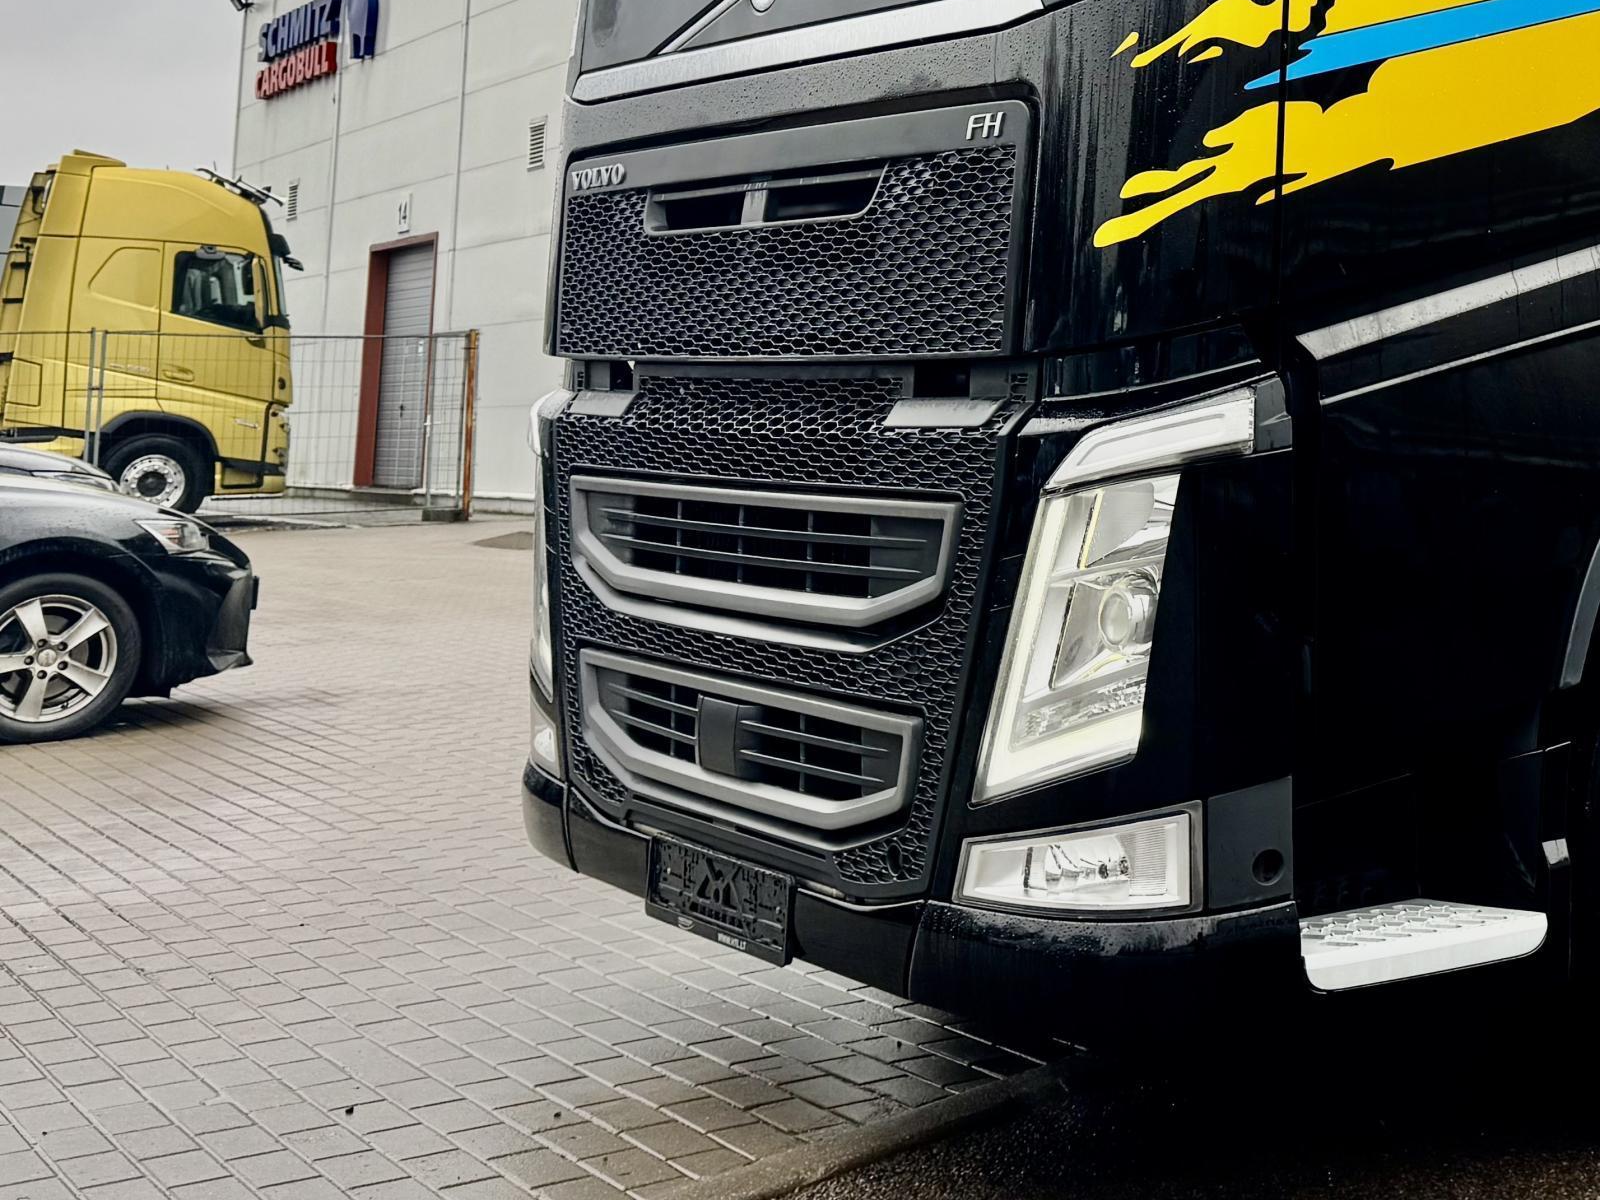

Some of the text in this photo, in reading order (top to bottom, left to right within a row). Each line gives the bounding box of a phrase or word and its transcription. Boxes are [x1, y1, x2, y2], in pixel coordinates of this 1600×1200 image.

[255, 41, 338, 100] CARGOBULL
[965, 111, 1005, 141] FH
[571, 163, 626, 191] VOLVO
[398, 201, 408, 225] 14
